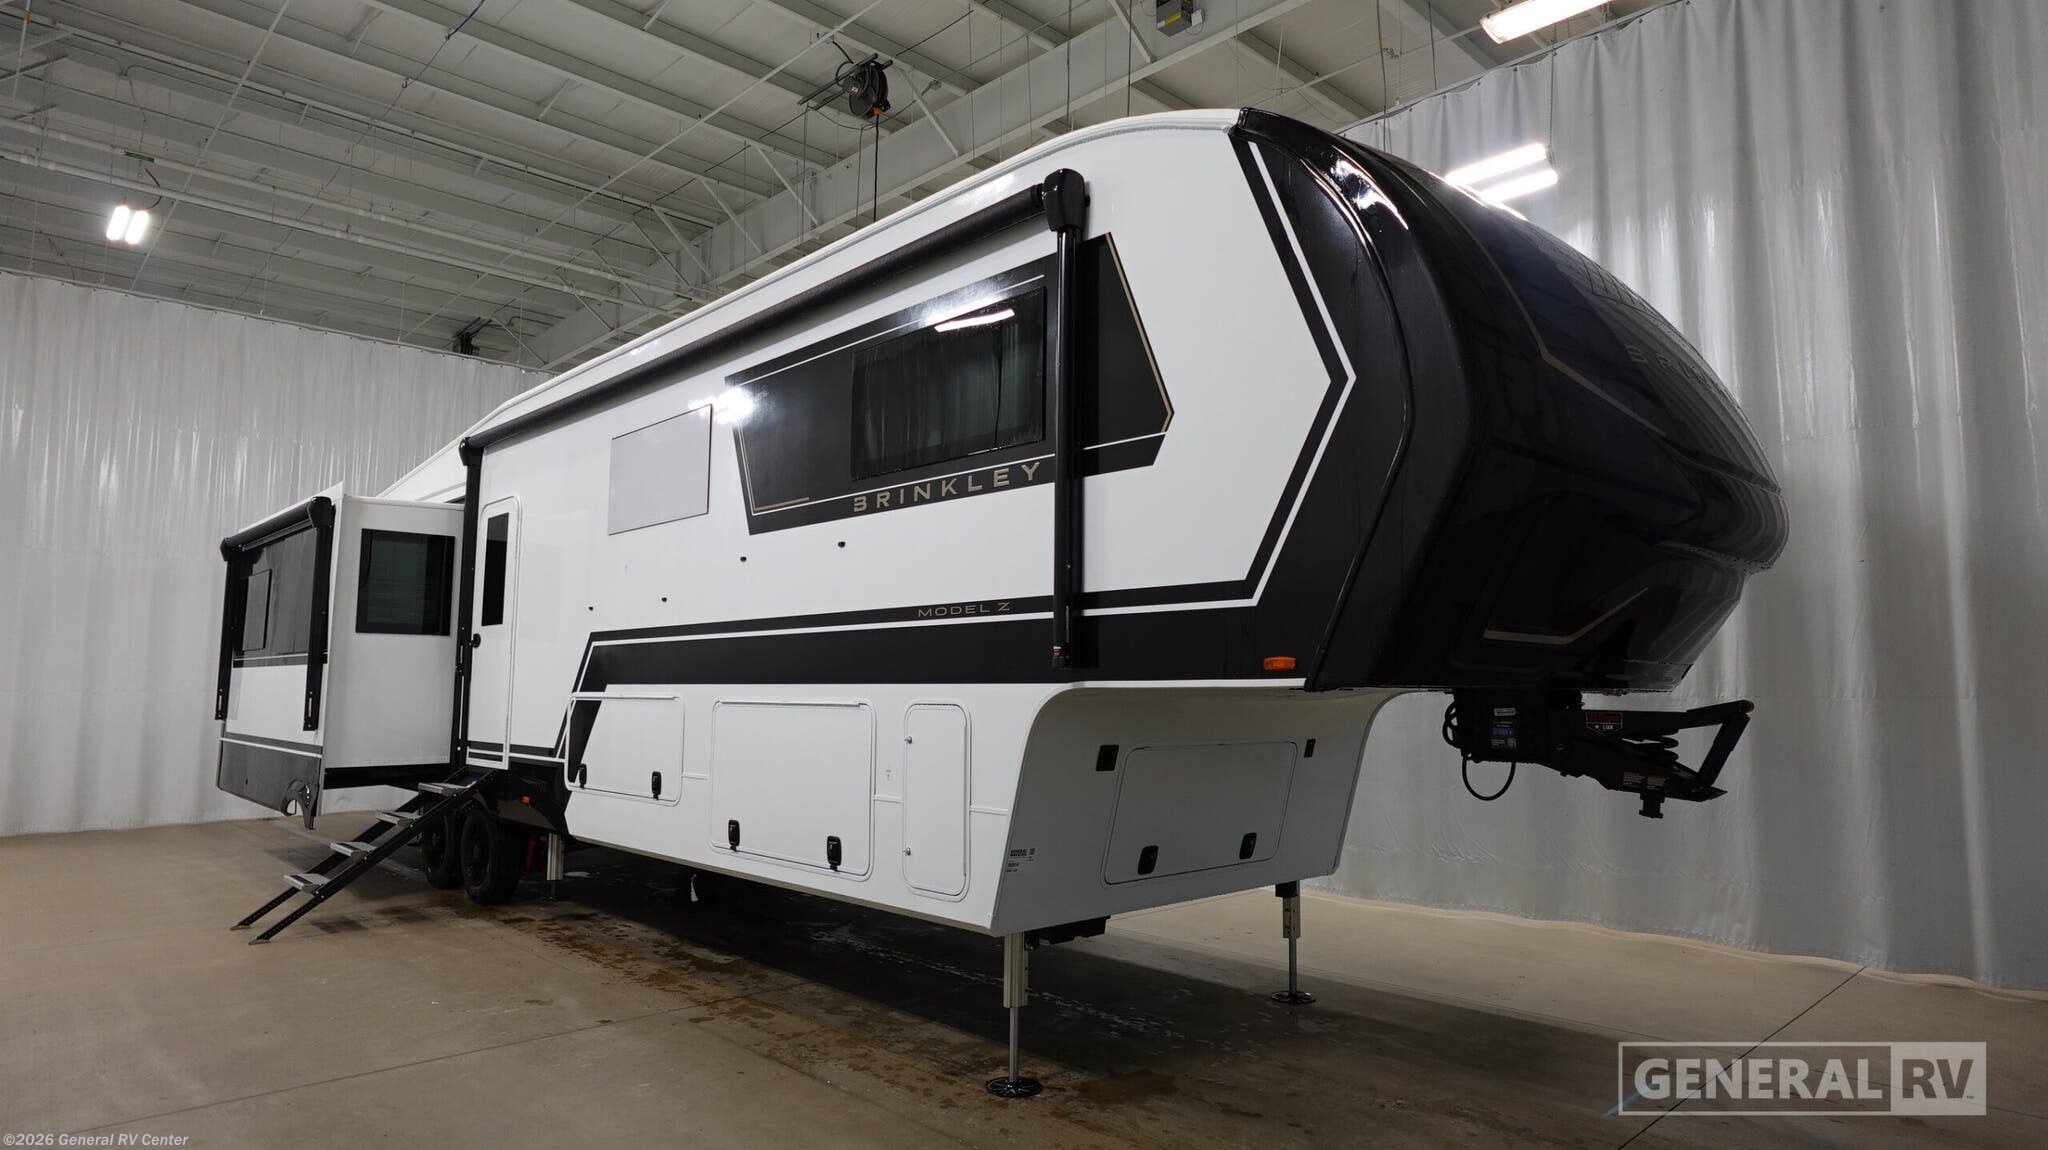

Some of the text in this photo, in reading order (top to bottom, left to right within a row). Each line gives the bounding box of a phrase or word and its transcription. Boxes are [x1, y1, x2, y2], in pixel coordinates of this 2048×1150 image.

[853, 462, 1041, 513] BRINKLEY
[918, 601, 1011, 618] MODEL Z
